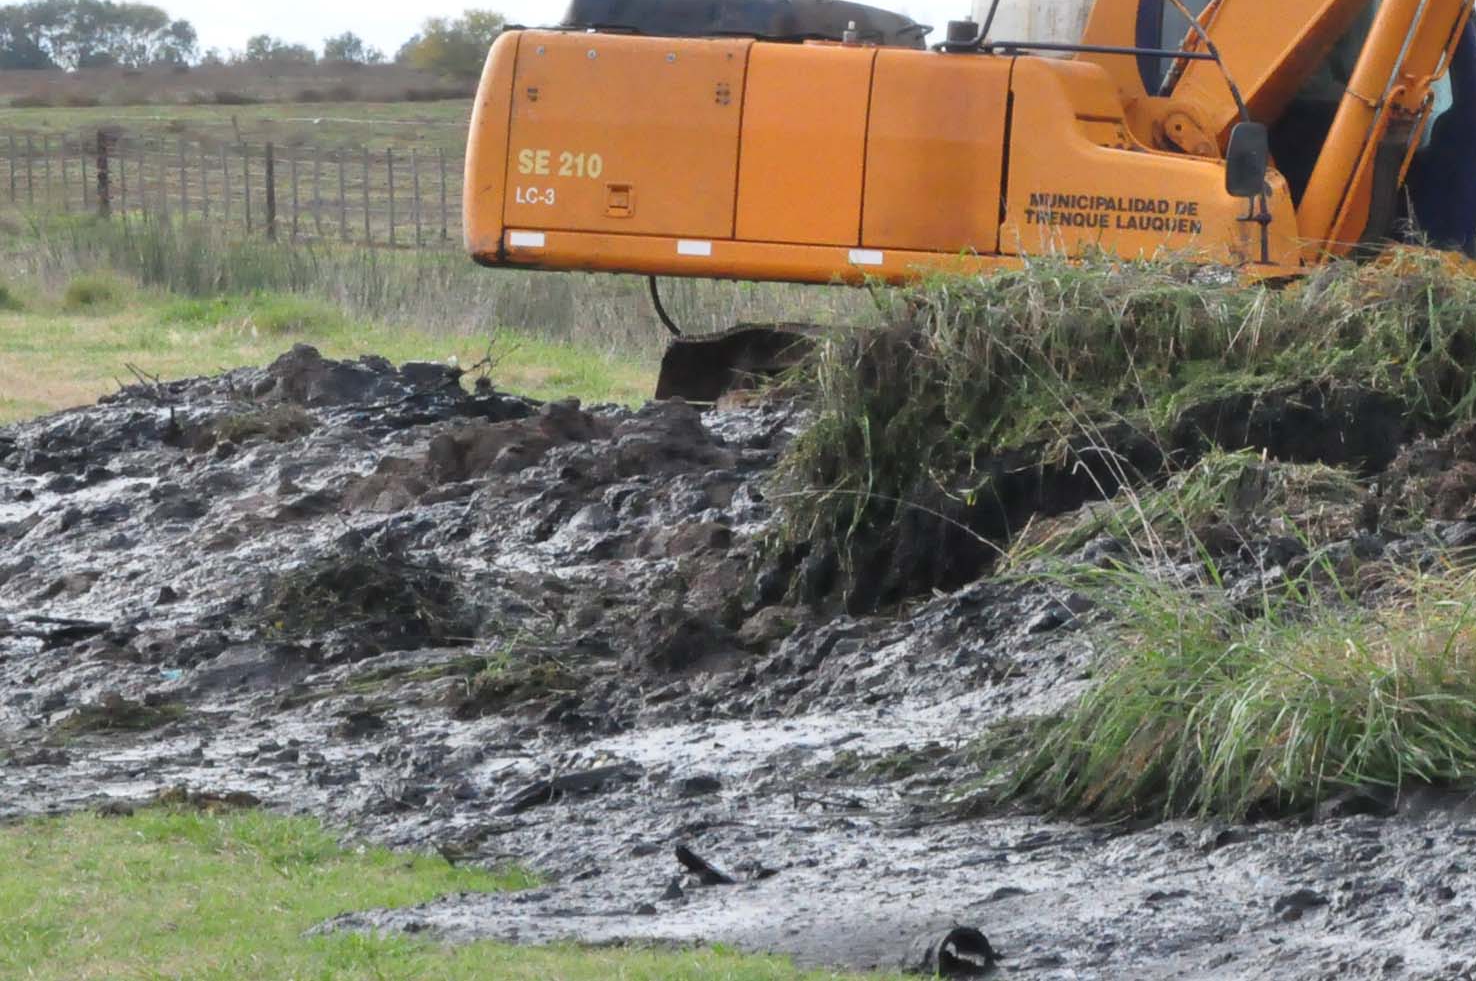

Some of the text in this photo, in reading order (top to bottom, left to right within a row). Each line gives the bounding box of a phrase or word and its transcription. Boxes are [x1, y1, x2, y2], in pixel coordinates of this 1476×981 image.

[518, 149, 603, 178] SE 210
[516, 186, 555, 205] LC-3
[1029, 193, 1198, 216] MUNICIPALIDAD DE
[1116, 215, 1202, 234] LAUQUEN
